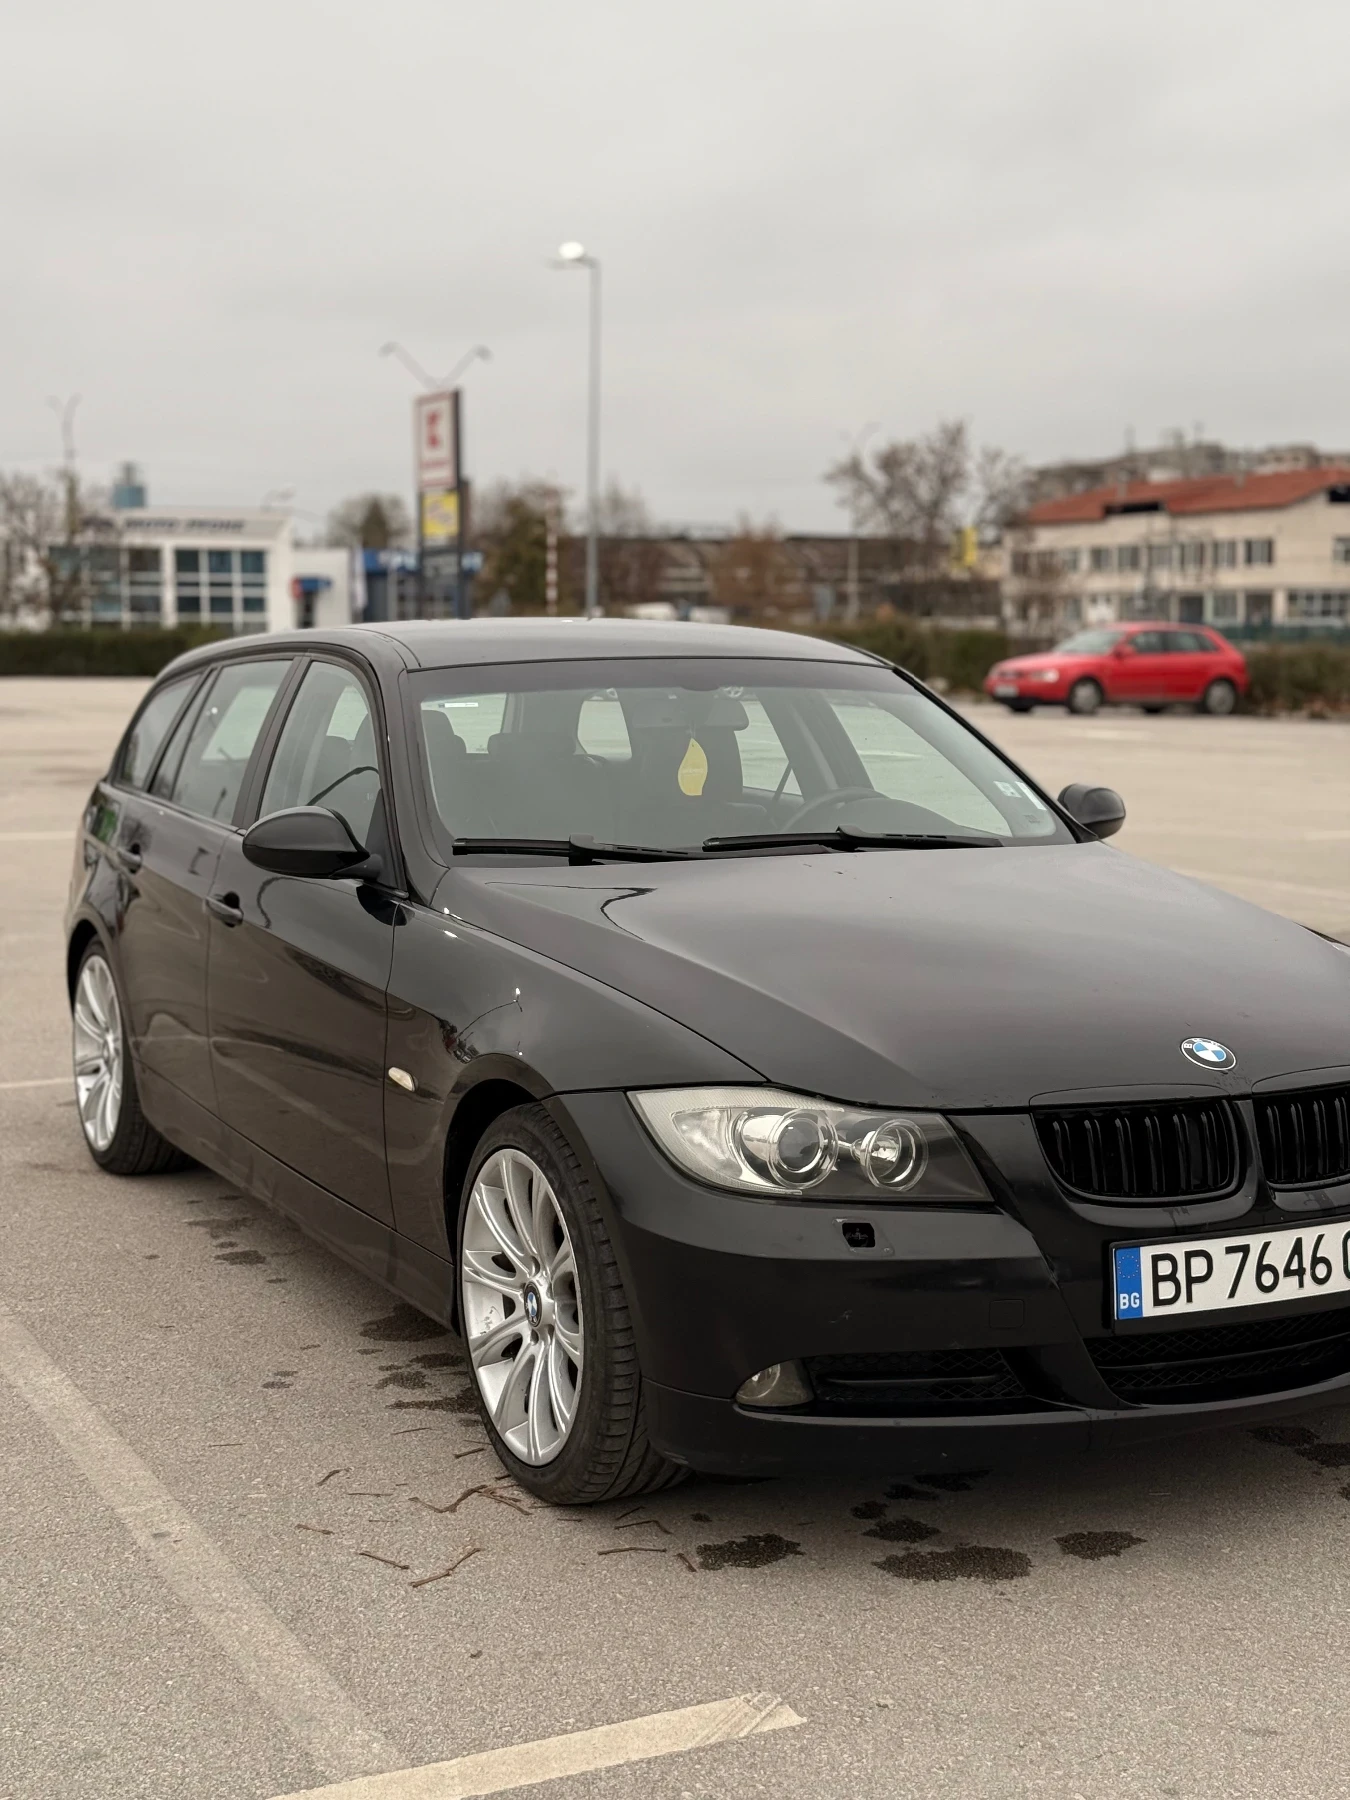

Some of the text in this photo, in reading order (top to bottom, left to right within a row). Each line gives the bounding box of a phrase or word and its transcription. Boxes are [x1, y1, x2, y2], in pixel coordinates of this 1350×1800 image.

[1151, 1249, 1213, 1307] BP
[1225, 1233, 1333, 1299] 7646
[1119, 1292, 1140, 1309] BG
